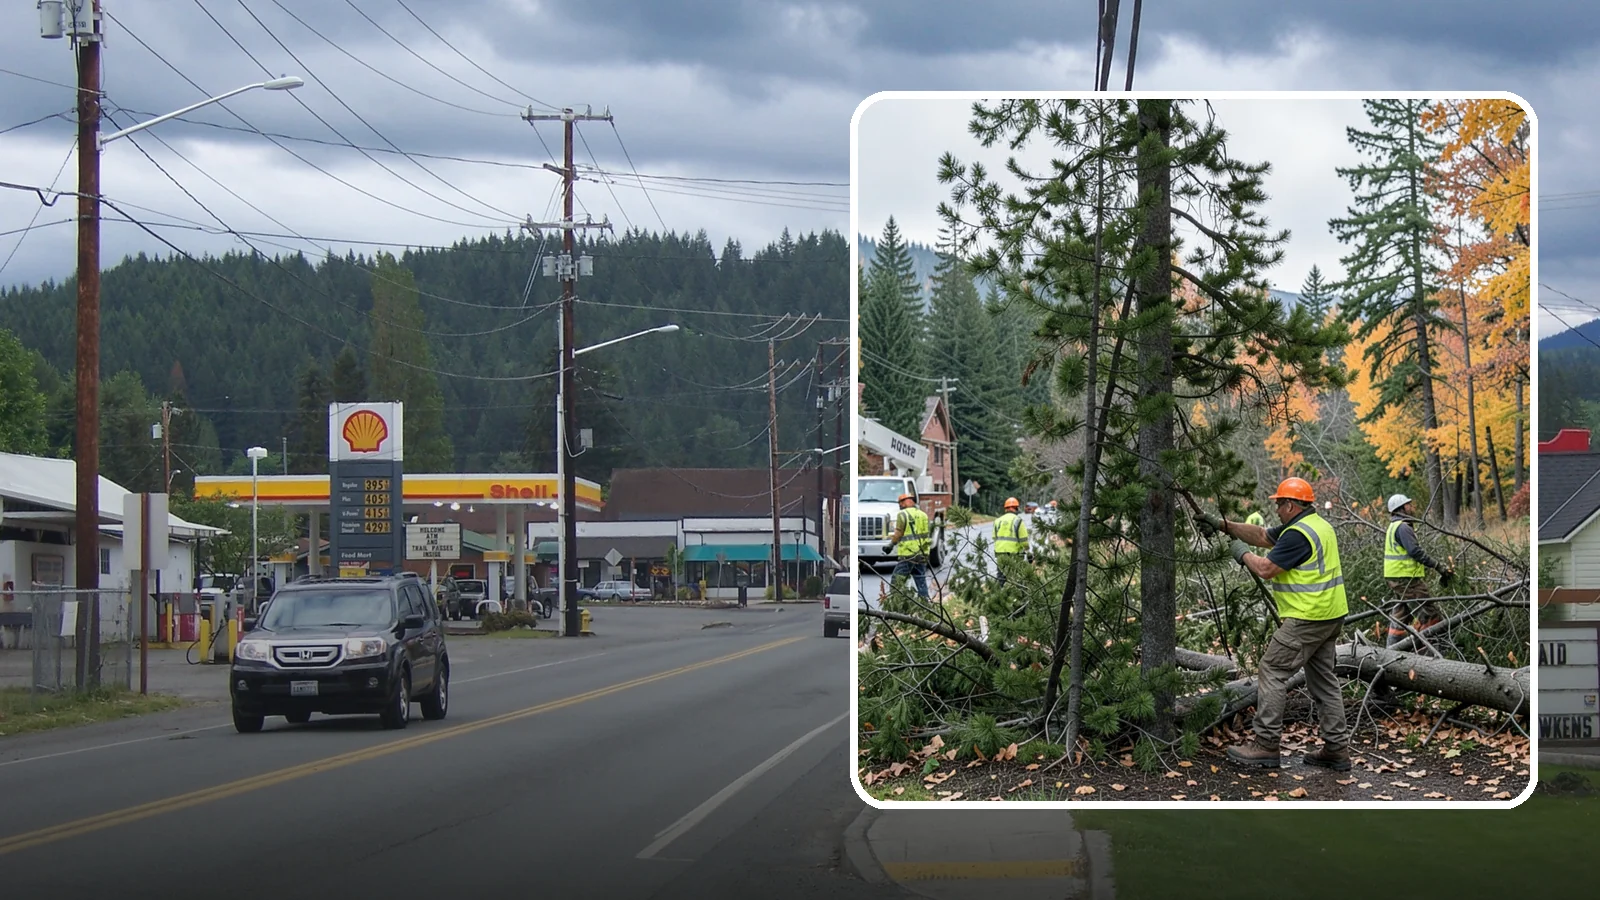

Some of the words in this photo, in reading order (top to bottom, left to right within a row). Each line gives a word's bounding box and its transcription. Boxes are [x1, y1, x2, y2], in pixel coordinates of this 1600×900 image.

[490, 484, 547, 499] Shell
[1538, 642, 1566, 665] AID
[1538, 716, 1592, 738] WKENS
